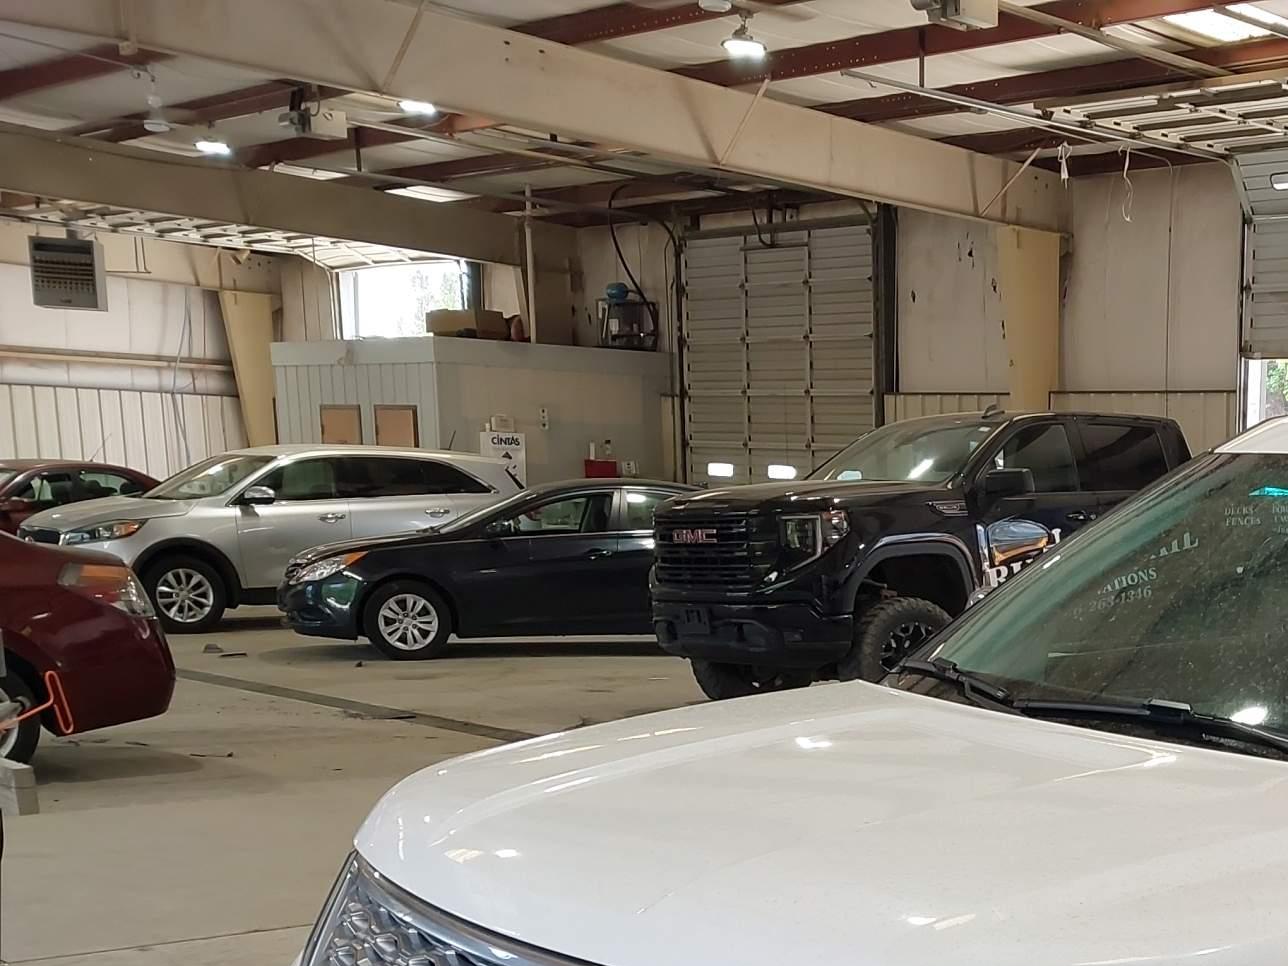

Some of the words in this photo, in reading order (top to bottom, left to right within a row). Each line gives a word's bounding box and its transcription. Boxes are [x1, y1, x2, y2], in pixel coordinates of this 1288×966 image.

[490, 433, 521, 447] CINTAS
[671, 528, 719, 544] GMC
[1097, 567, 1158, 595] ATIONS
